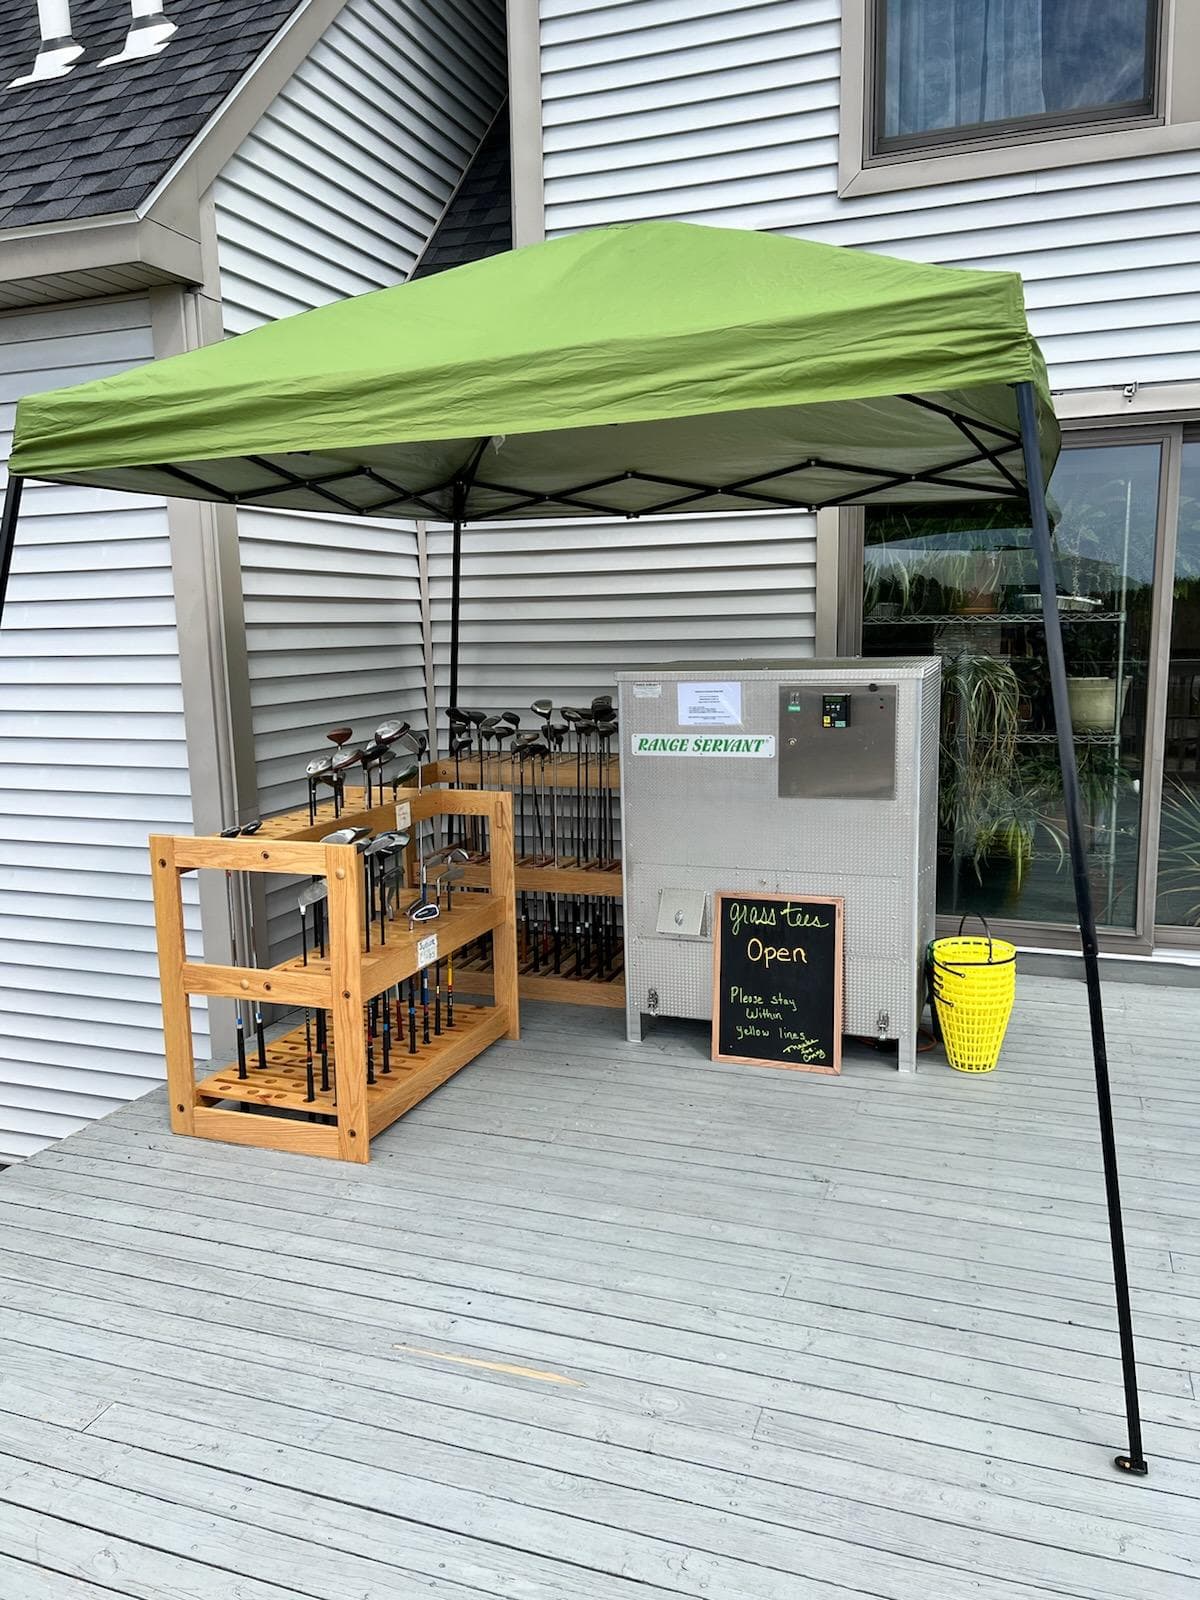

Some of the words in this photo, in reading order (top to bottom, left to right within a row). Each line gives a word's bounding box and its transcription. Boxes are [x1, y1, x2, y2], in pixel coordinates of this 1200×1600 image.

[638, 738, 688, 752] RANGE
[693, 738, 764, 753] SERVANT
[730, 903, 776, 935] grass
[780, 901, 829, 927] tees
[747, 938, 808, 968] Open
[730, 986, 764, 1004] Please
[770, 992, 797, 1012] stay
[779, 1026, 806, 1040] lines
